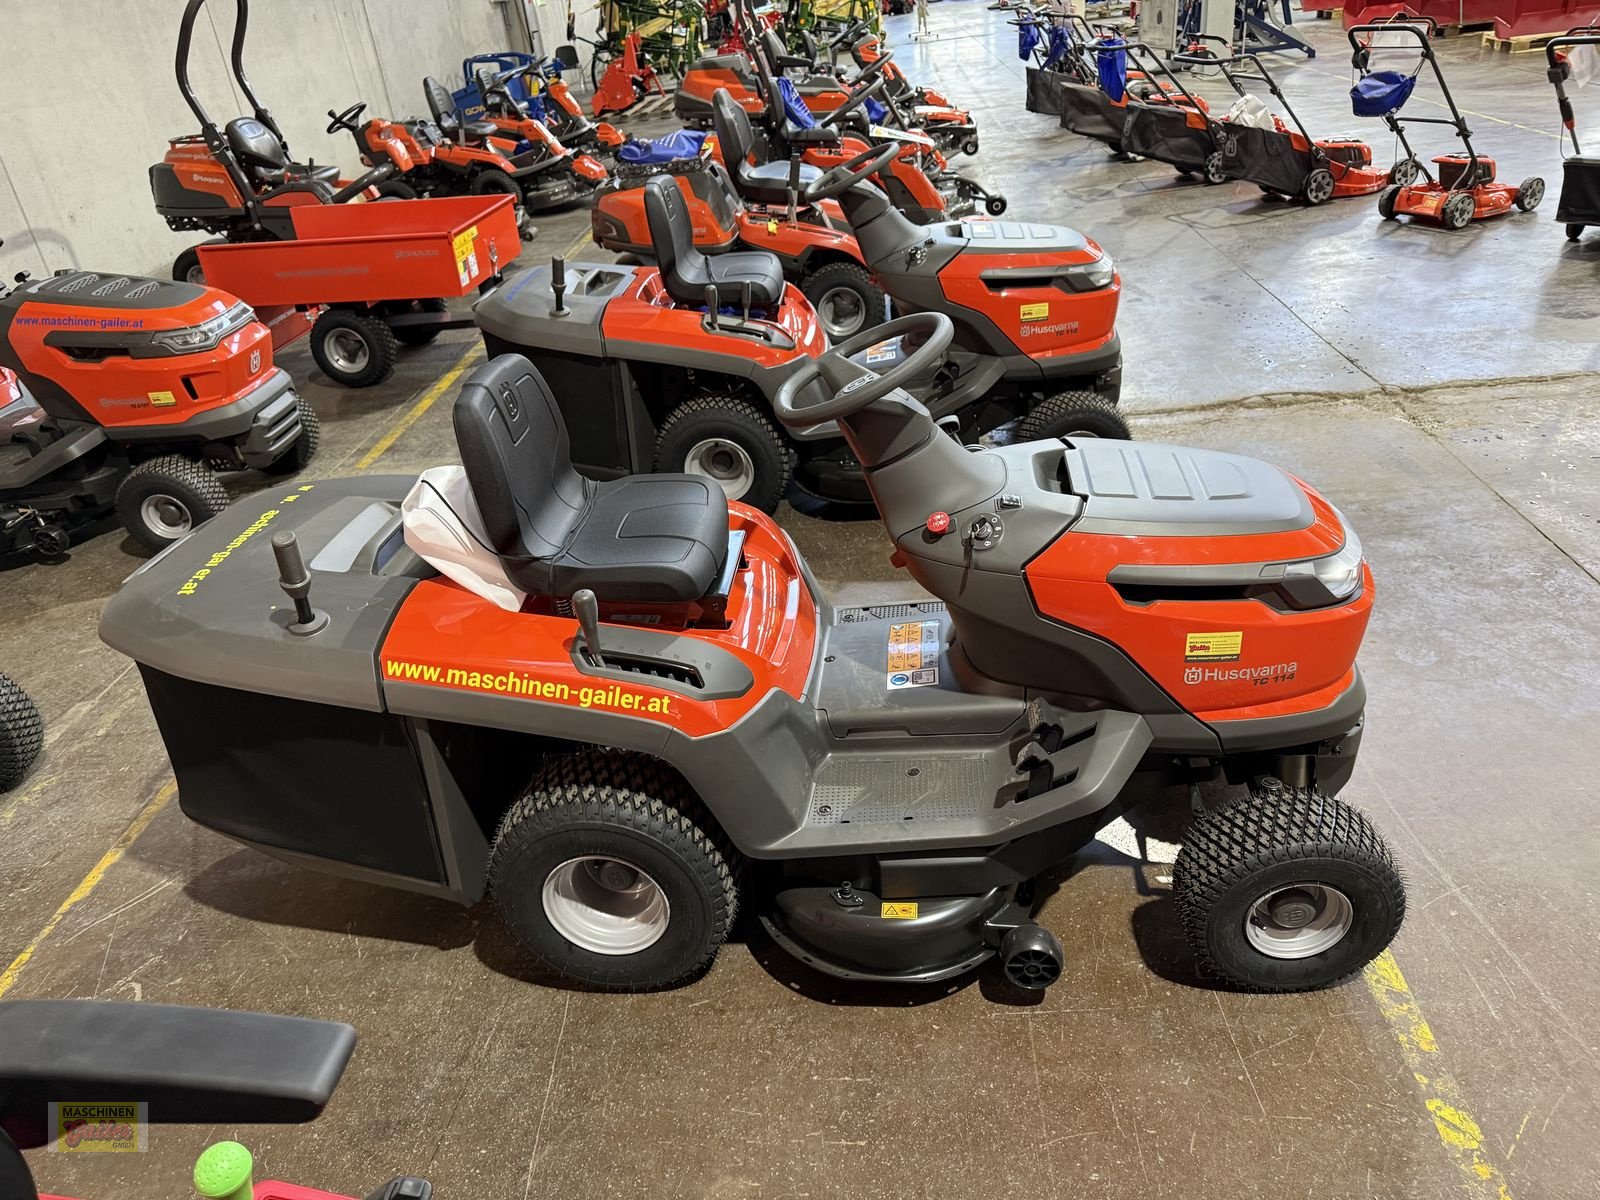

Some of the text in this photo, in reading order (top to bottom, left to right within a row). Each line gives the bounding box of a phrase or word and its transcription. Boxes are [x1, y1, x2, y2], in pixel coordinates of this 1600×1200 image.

[15, 316, 143, 328] www.maschinen-gailer.at
[1030, 321, 1079, 335] Husqvarna
[1204, 661, 1298, 681] Husqvarna
[386, 660, 670, 713] www.maschinen-gailer.at
[1253, 673, 1295, 686] TC 114
